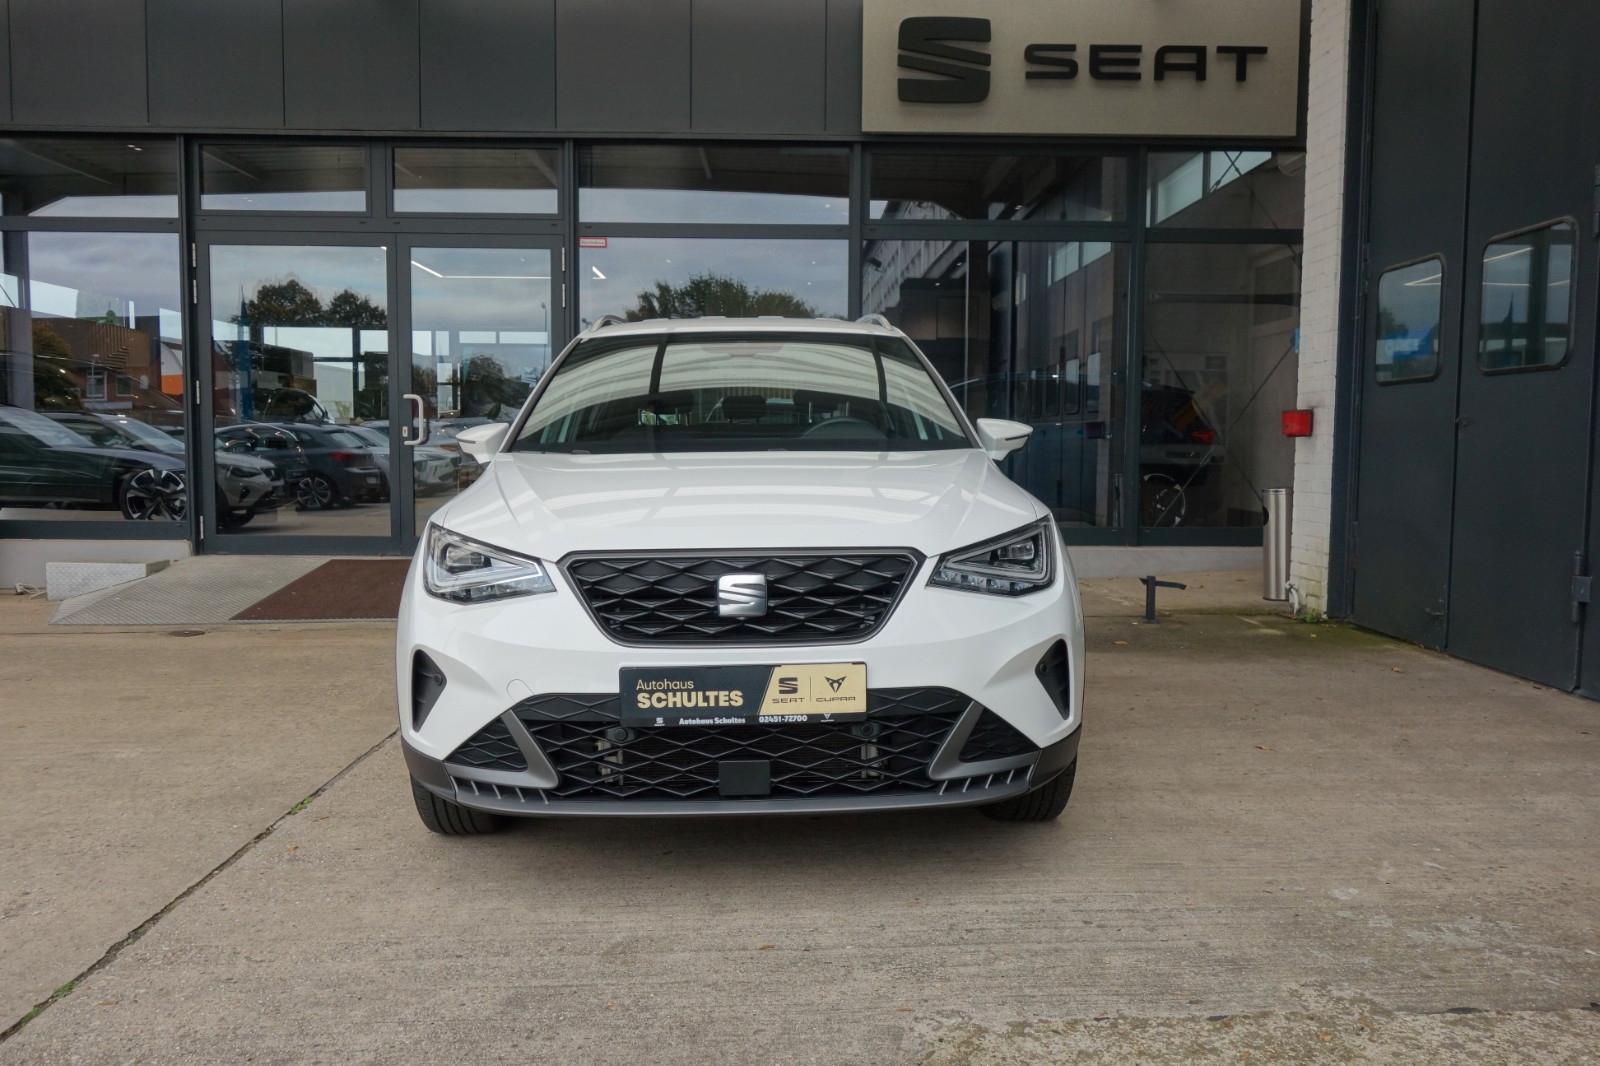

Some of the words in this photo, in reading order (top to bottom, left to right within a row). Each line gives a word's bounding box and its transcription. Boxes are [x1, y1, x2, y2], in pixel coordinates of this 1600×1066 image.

[1024, 44, 1268, 82] SEAT
[636, 678, 694, 691] Autohaus
[636, 690, 744, 708] SCHULTES
[678, 717, 713, 725] Autohaus
[758, 715, 808, 723] 02451-72700
